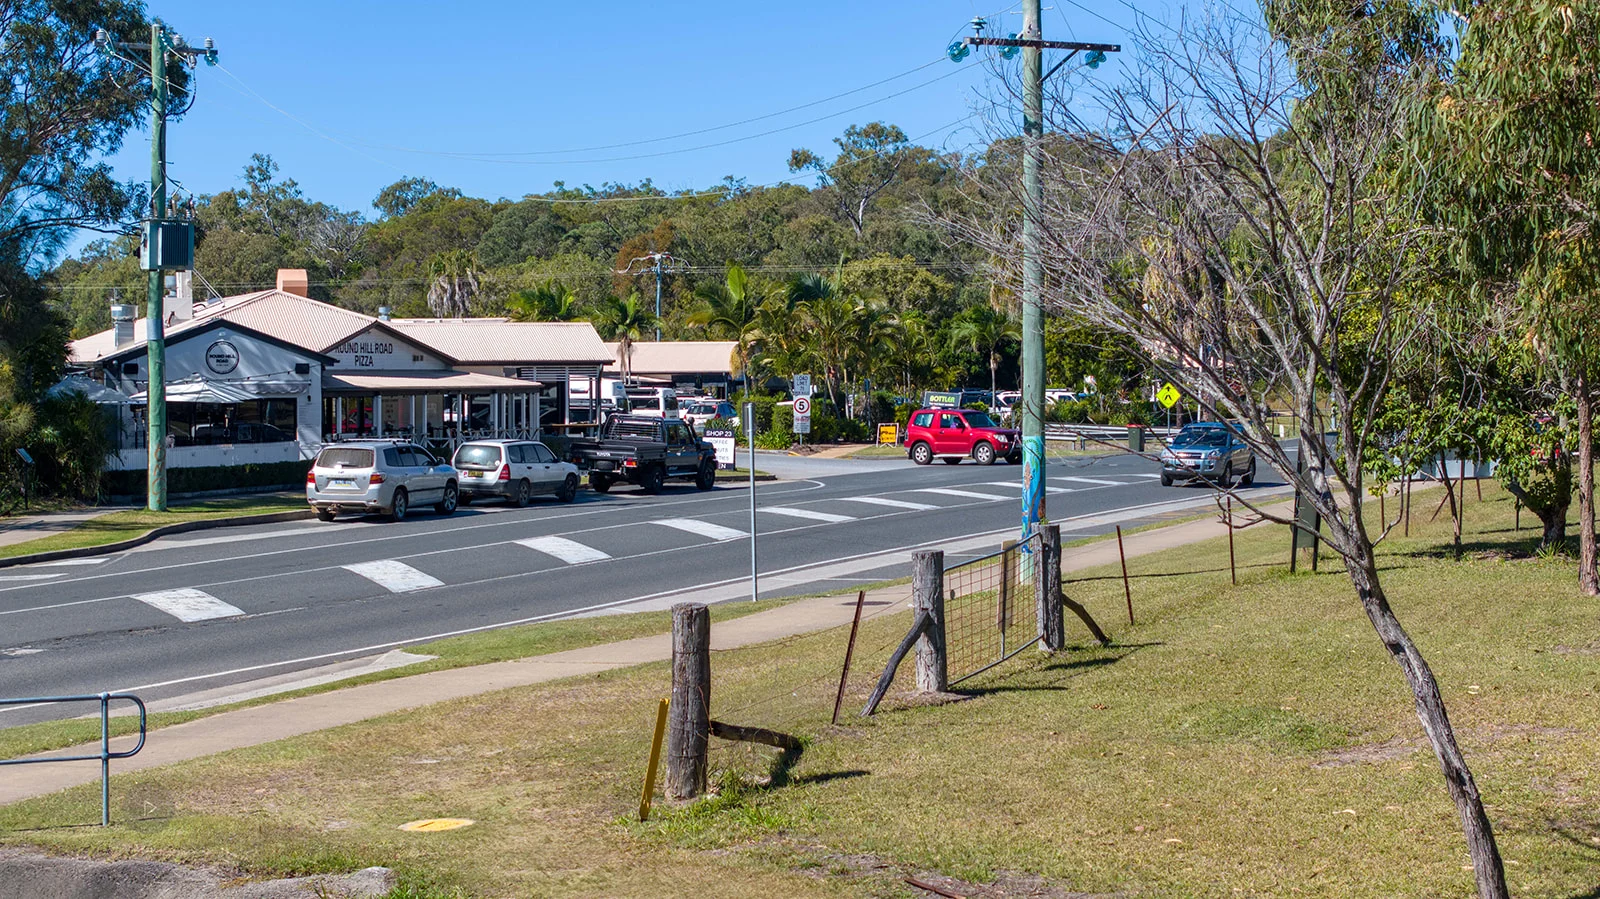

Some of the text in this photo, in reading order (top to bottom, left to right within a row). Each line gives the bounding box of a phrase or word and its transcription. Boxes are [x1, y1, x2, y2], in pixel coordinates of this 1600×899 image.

[360, 343, 373, 354] HILL
[375, 343, 393, 354] ROAD
[354, 355, 374, 367] PIZZA
[798, 401, 805, 411] 5
